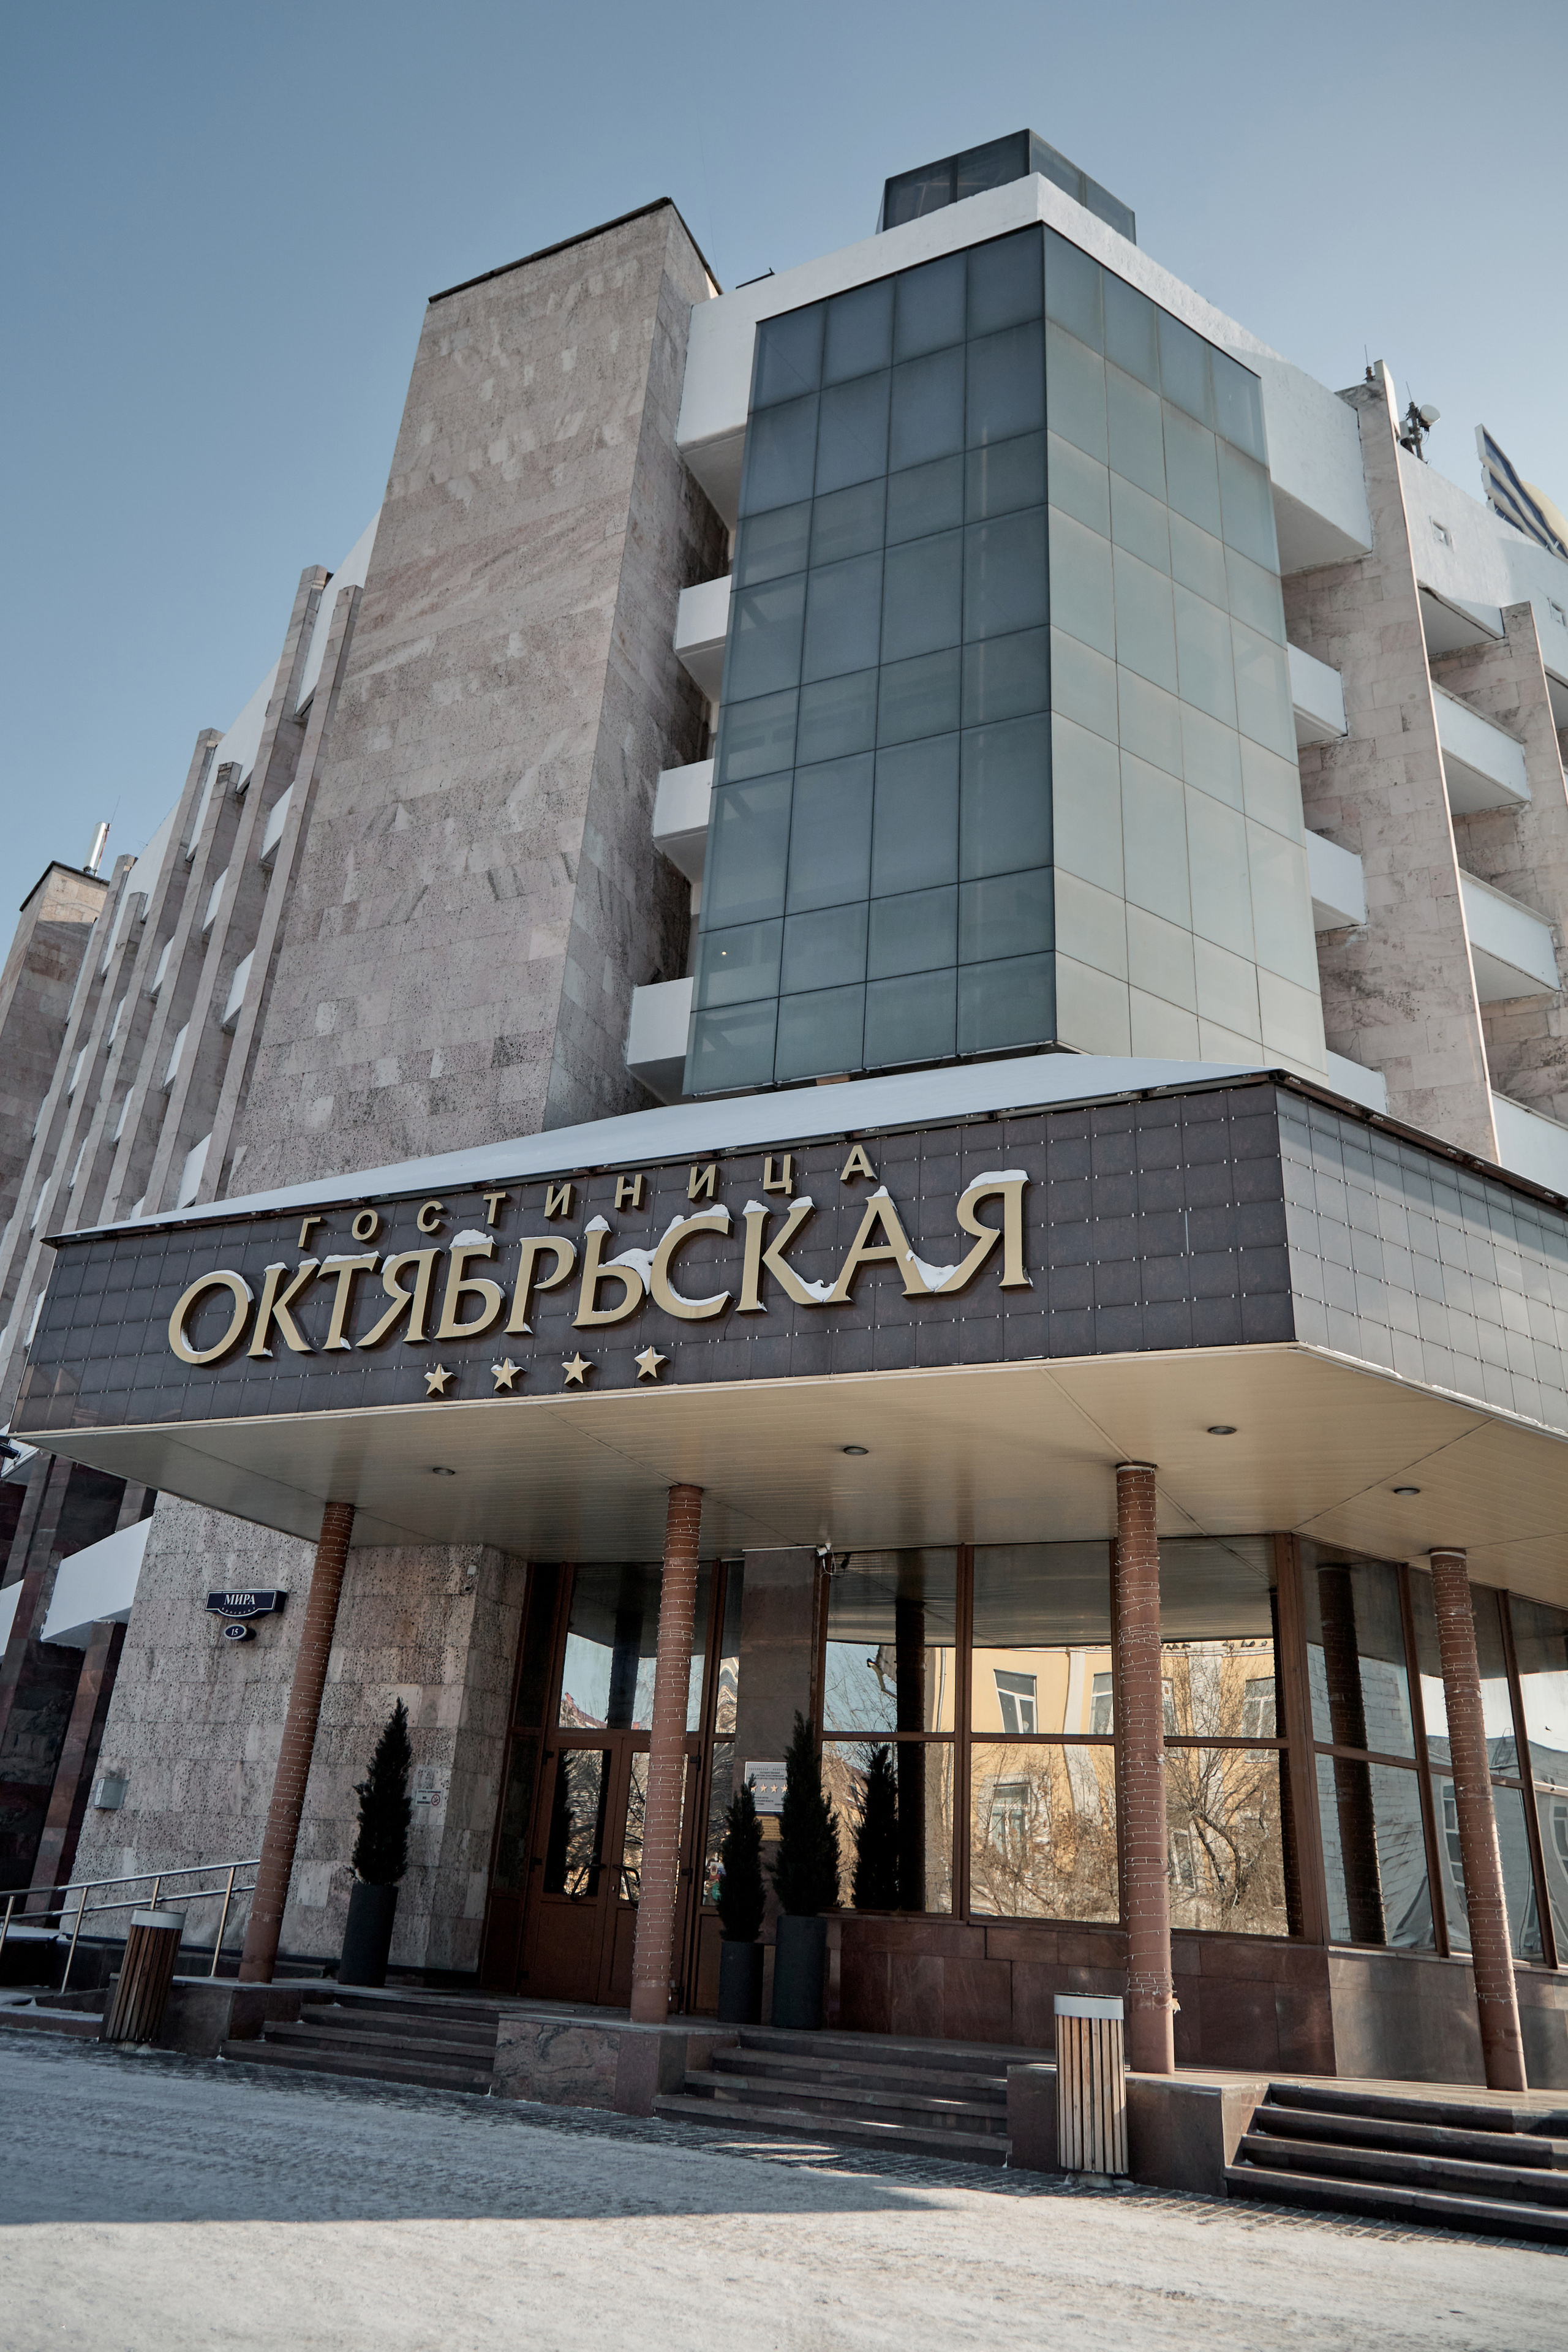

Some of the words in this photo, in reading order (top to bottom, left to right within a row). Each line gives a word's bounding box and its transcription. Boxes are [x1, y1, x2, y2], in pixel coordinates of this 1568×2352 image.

[298, 1144, 877, 1250] ГОСТИНИЦА
[168, 1169, 1033, 1366] ОКТЯБРЬСКАЯ
[224, 1594, 255, 1605] МИРА
